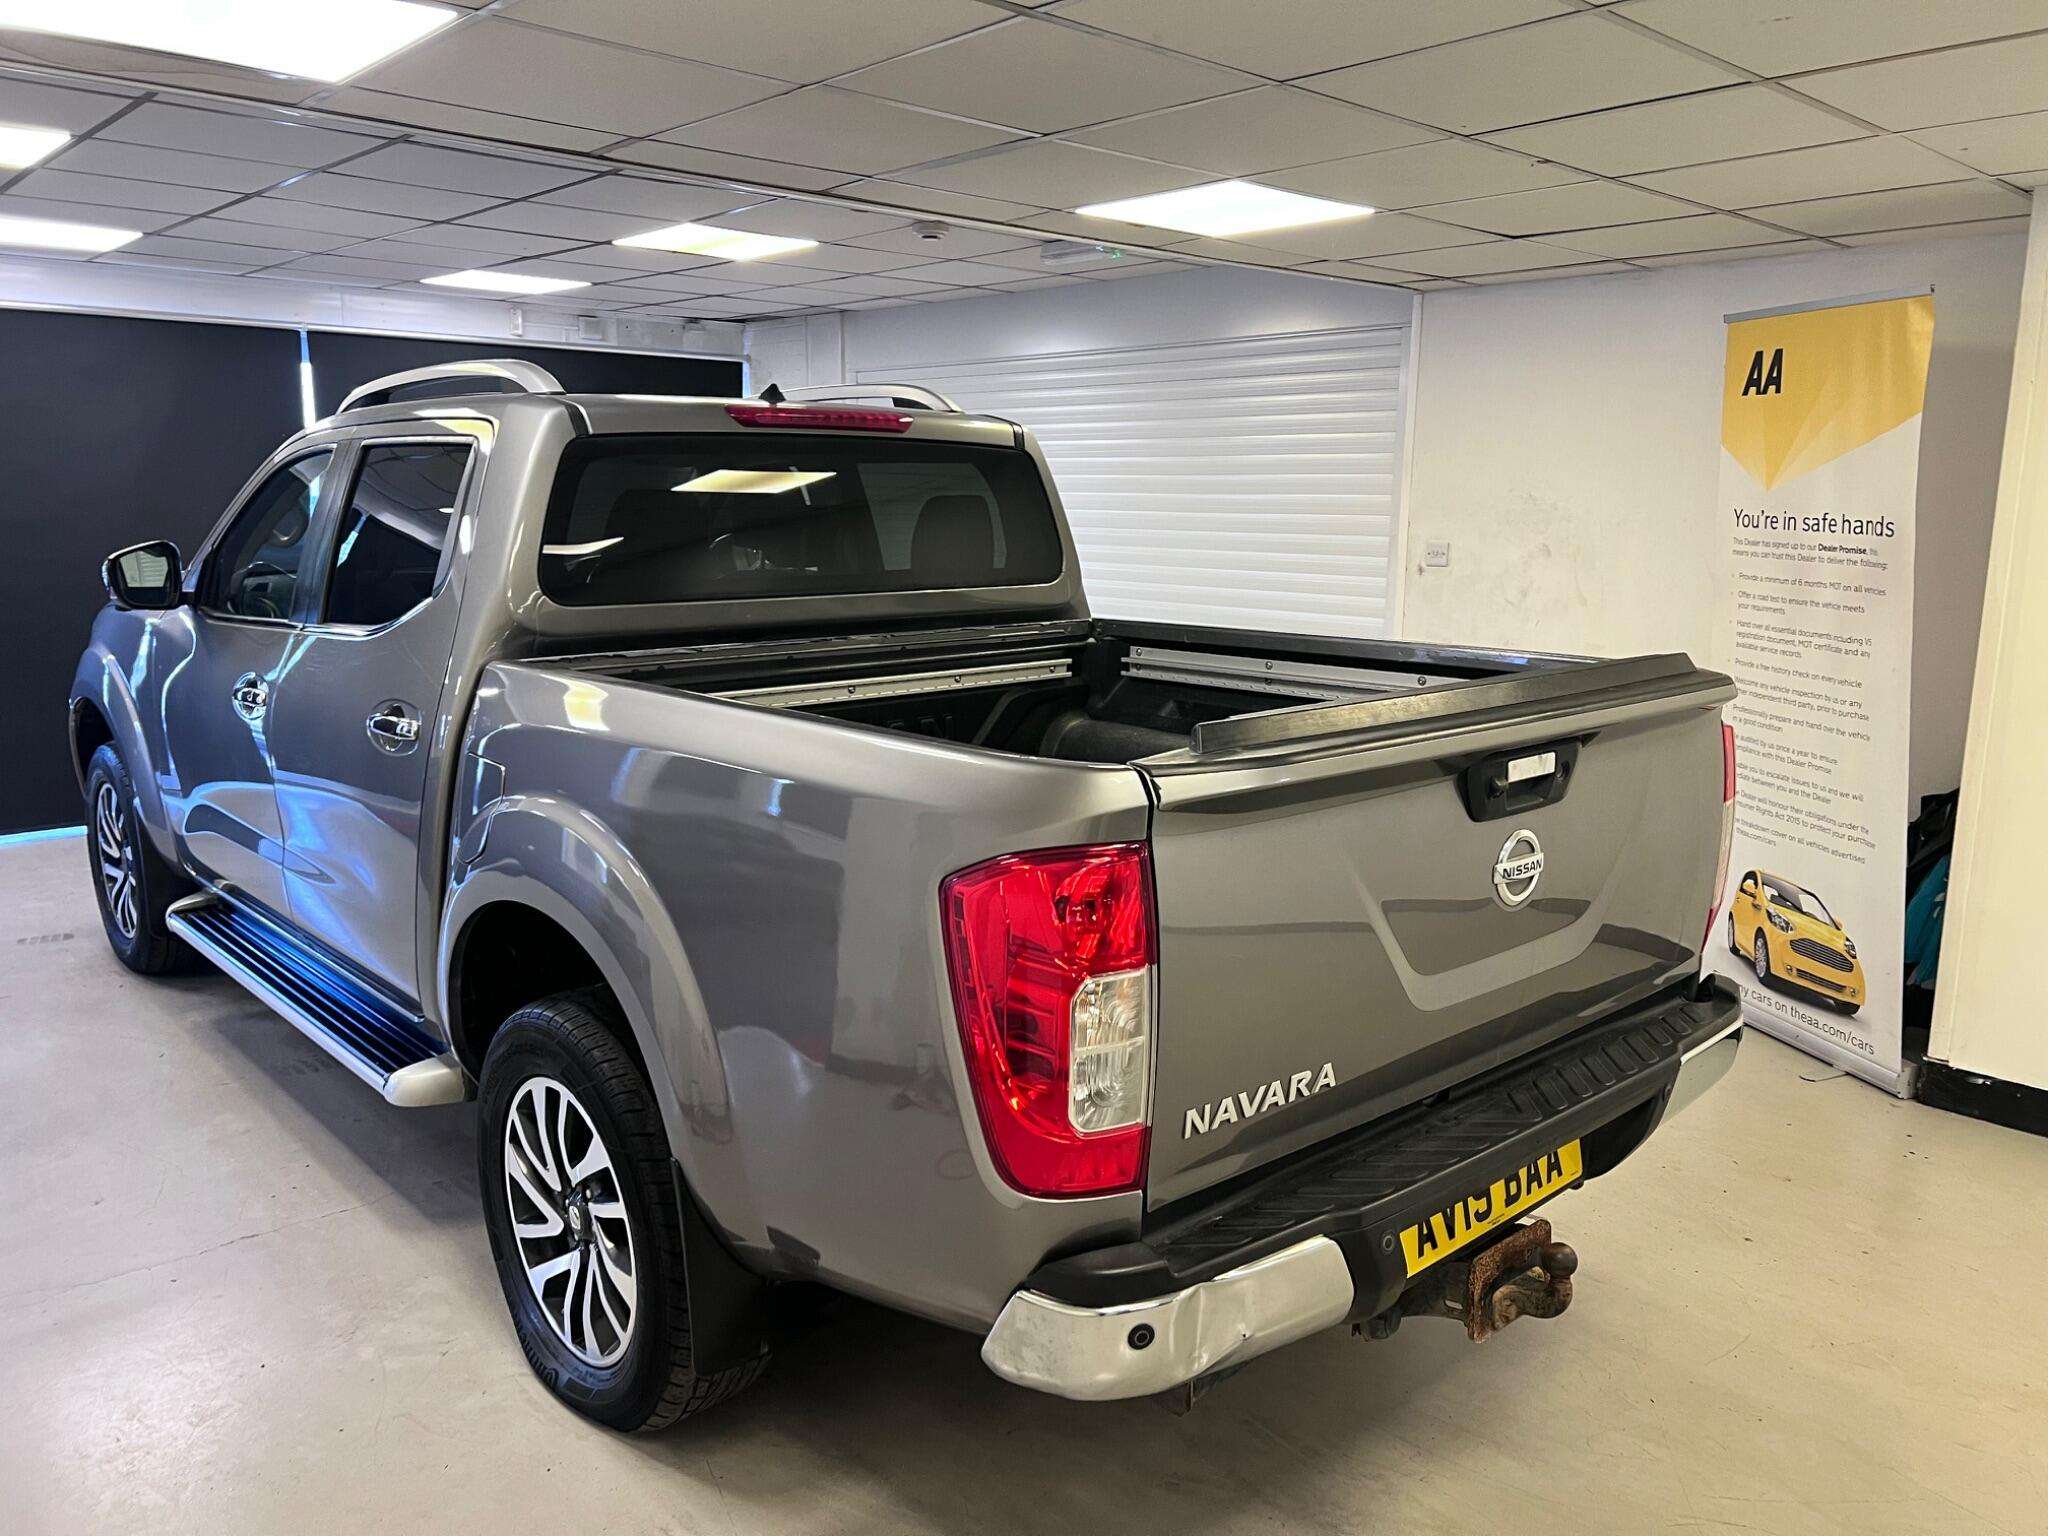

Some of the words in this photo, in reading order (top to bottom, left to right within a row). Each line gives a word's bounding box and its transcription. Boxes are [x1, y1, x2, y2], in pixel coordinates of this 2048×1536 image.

[1742, 348, 1783, 396] AA
[1734, 508, 1779, 530] You're
[1783, 511, 1796, 531] in
[1802, 513, 1837, 533] safe
[1841, 514, 1895, 538] hands
[1818, 543, 1838, 552] Dealer
[1846, 558, 1858, 566] the
[1502, 860, 1542, 878] NISSAN
[1751, 990, 1773, 1008] cars
[1774, 1001, 1788, 1014] on
[1790, 1006, 1875, 1056] theaa.com/cars
[1183, 1061, 1337, 1140] NAVARA
